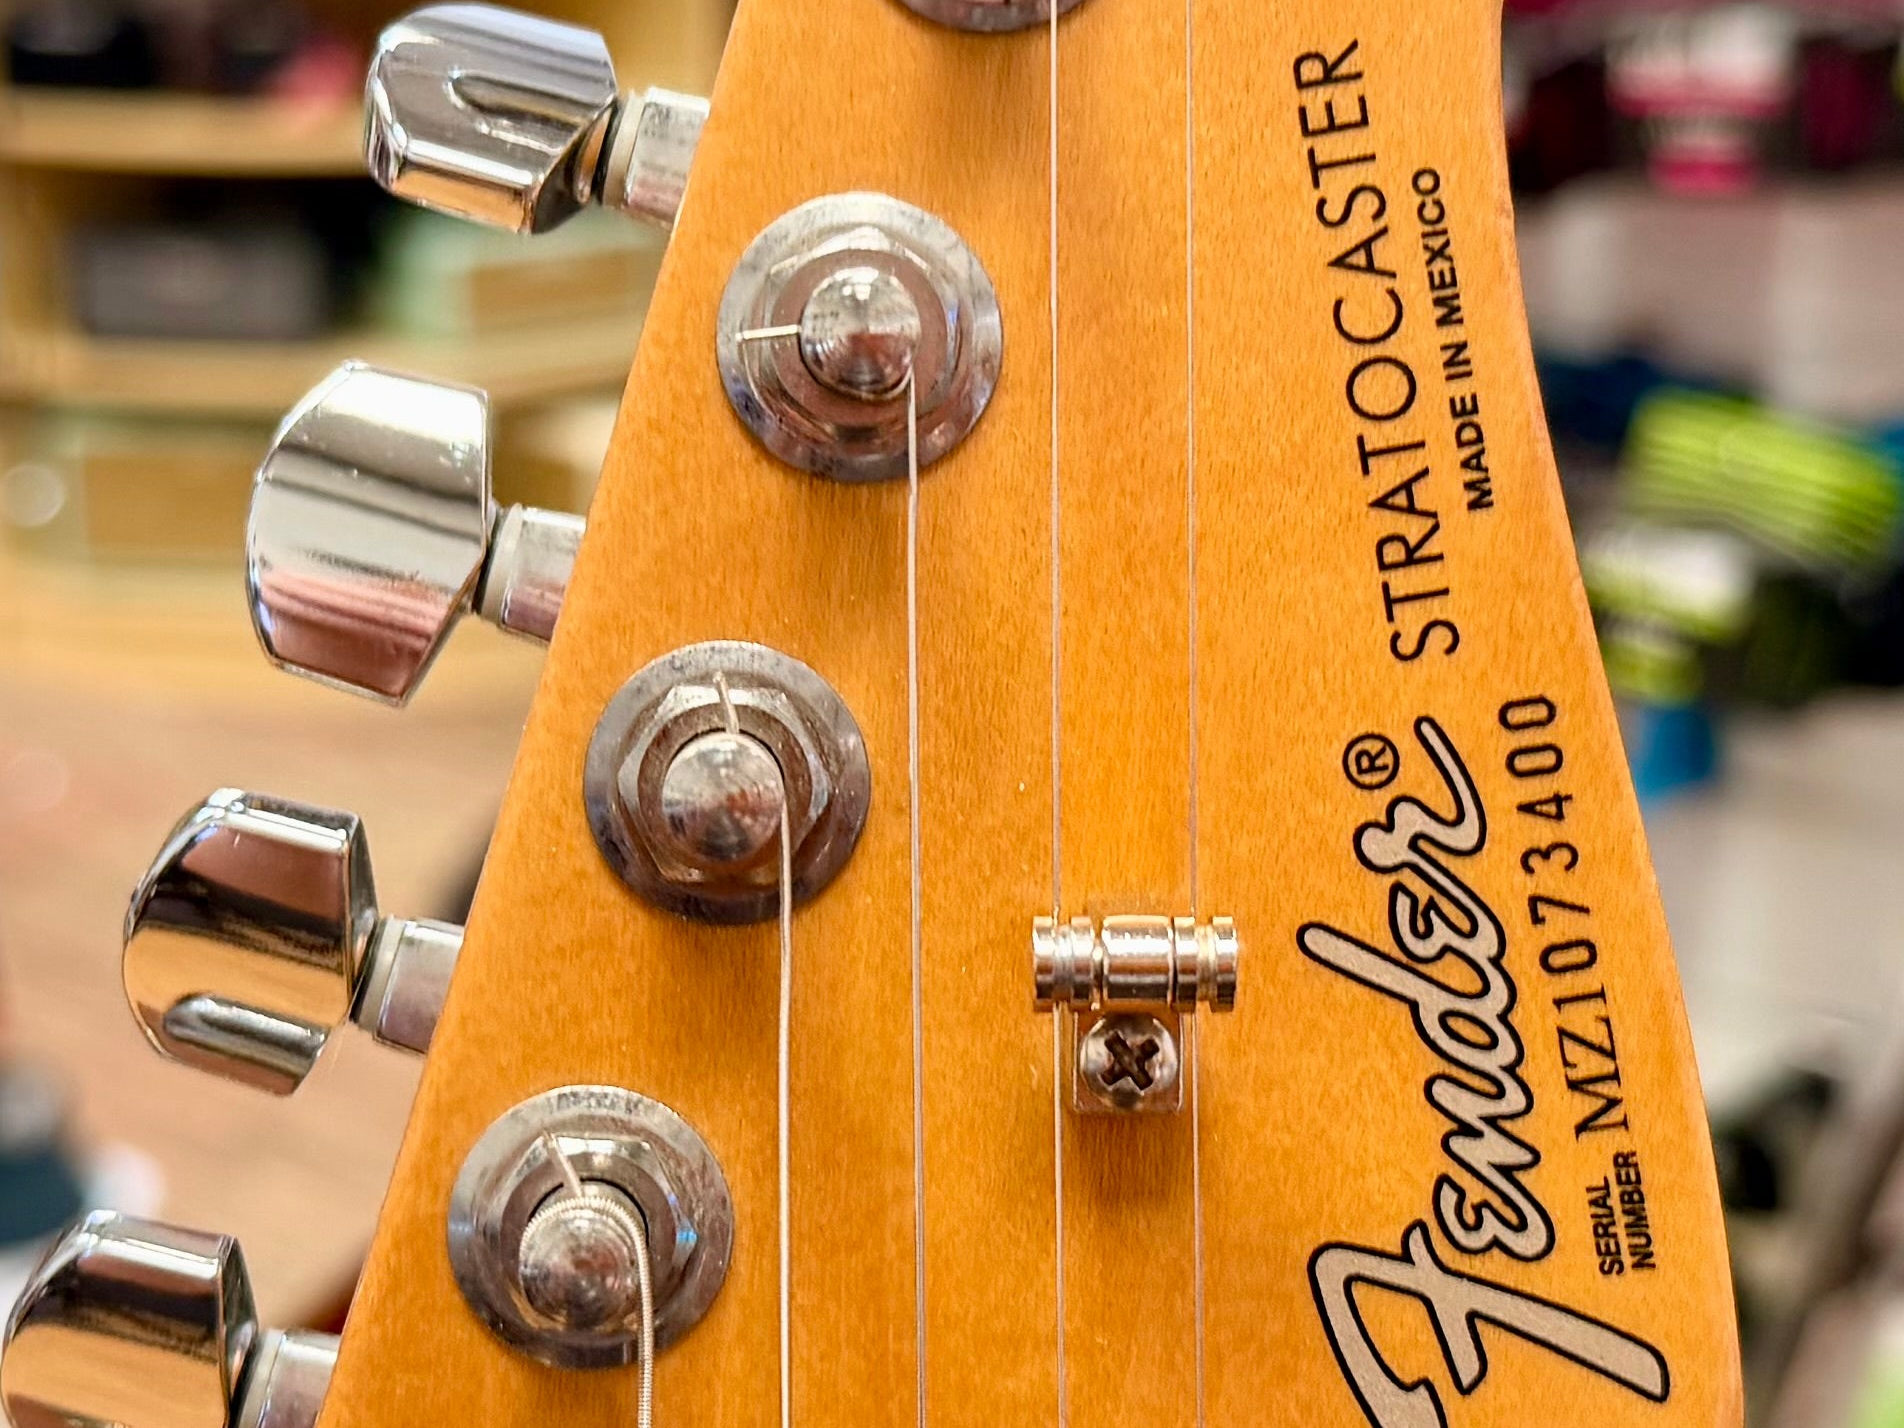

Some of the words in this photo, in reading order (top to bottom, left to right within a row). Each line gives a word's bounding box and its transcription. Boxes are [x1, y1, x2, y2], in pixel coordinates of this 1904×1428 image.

[1412, 168, 1464, 327] MEXICO
[1293, 39, 1460, 662] STRATOCASTER
[1440, 341, 1473, 381] IN
[1448, 394, 1494, 511] MADE
[1498, 696, 1629, 1139] MZ1073400
[1586, 1174, 1625, 1276] SERIAL
[1613, 1150, 1657, 1269] NUMBER
